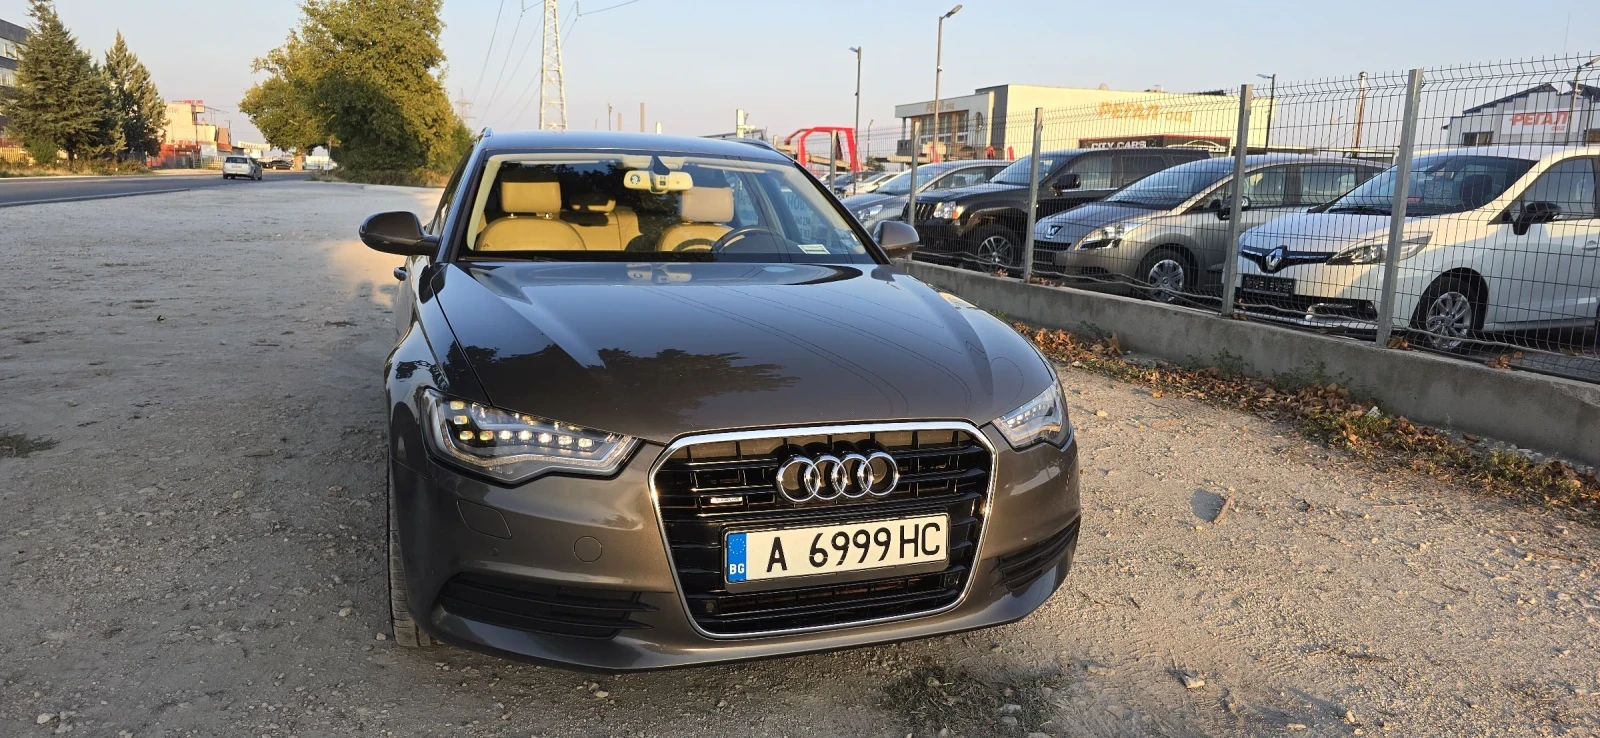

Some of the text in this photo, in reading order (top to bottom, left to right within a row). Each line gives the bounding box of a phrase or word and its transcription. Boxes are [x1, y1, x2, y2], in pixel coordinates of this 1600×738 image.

[1097, 102, 1159, 120] РЕГАЛ
[1511, 111, 1568, 125] РЕГАЛ
[1091, 140, 1147, 149] CITY CARS
[766, 522, 941, 573] A 6999 HC
[729, 563, 745, 575] BG
